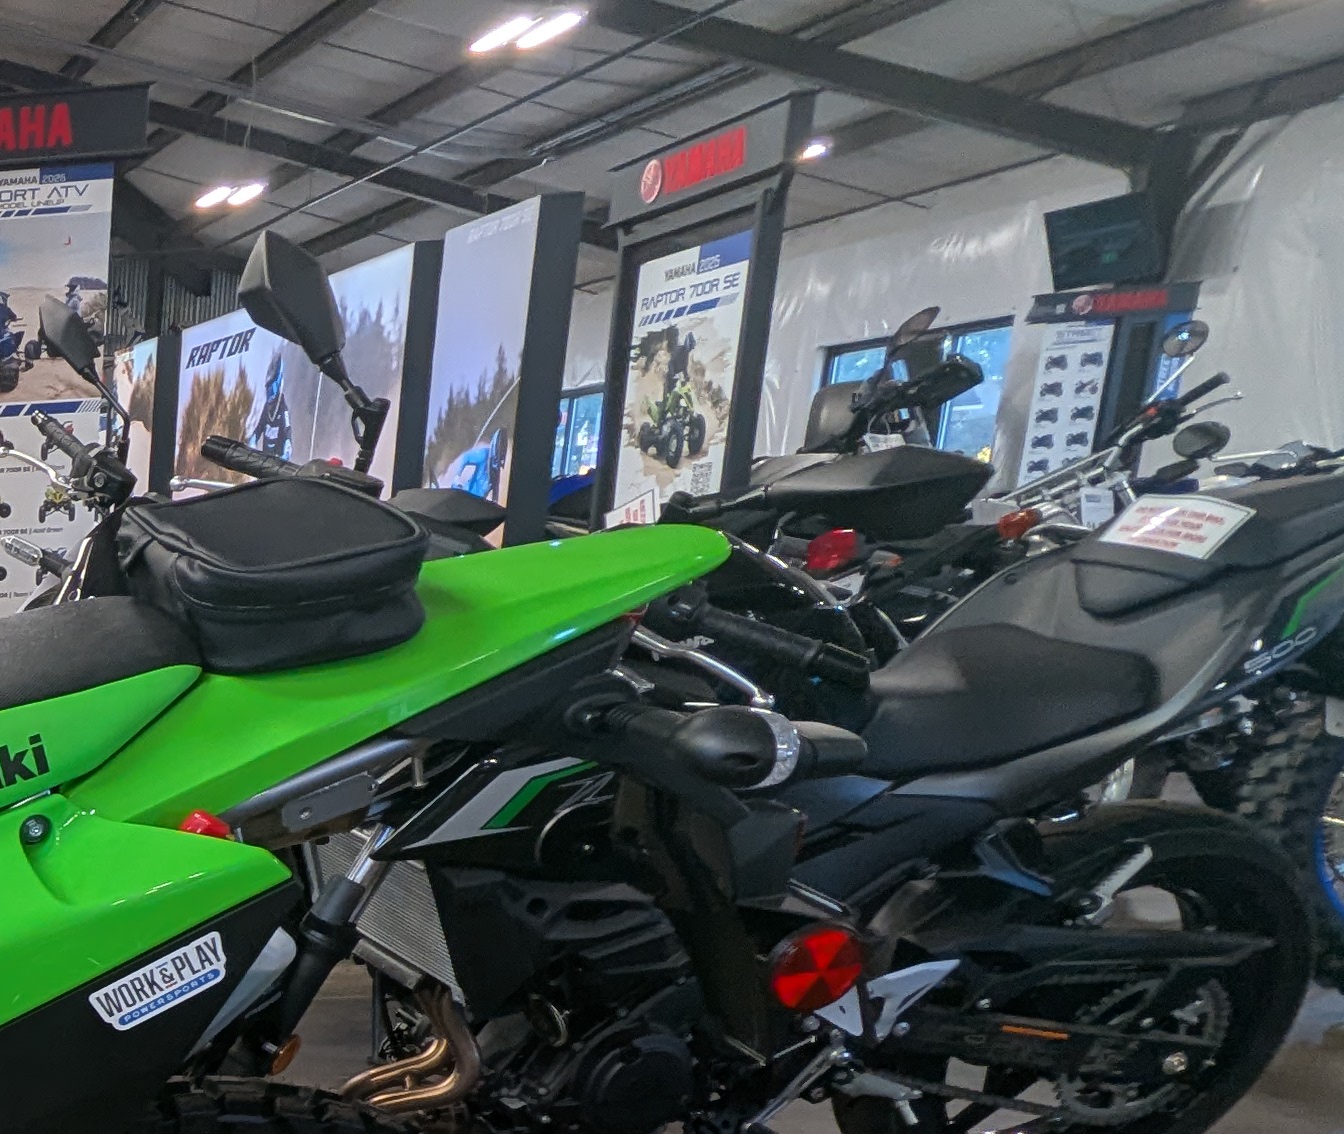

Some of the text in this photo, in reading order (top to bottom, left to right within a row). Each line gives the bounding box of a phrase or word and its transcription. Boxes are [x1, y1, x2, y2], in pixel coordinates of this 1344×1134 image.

[47, 184, 90, 199] ATV
[640, 272, 741, 312] RAPTOR 700R SE
[185, 326, 258, 370] RAPTOR
[1243, 626, 1318, 674] 500
[123, 972, 215, 1022] POWERSPORTS
